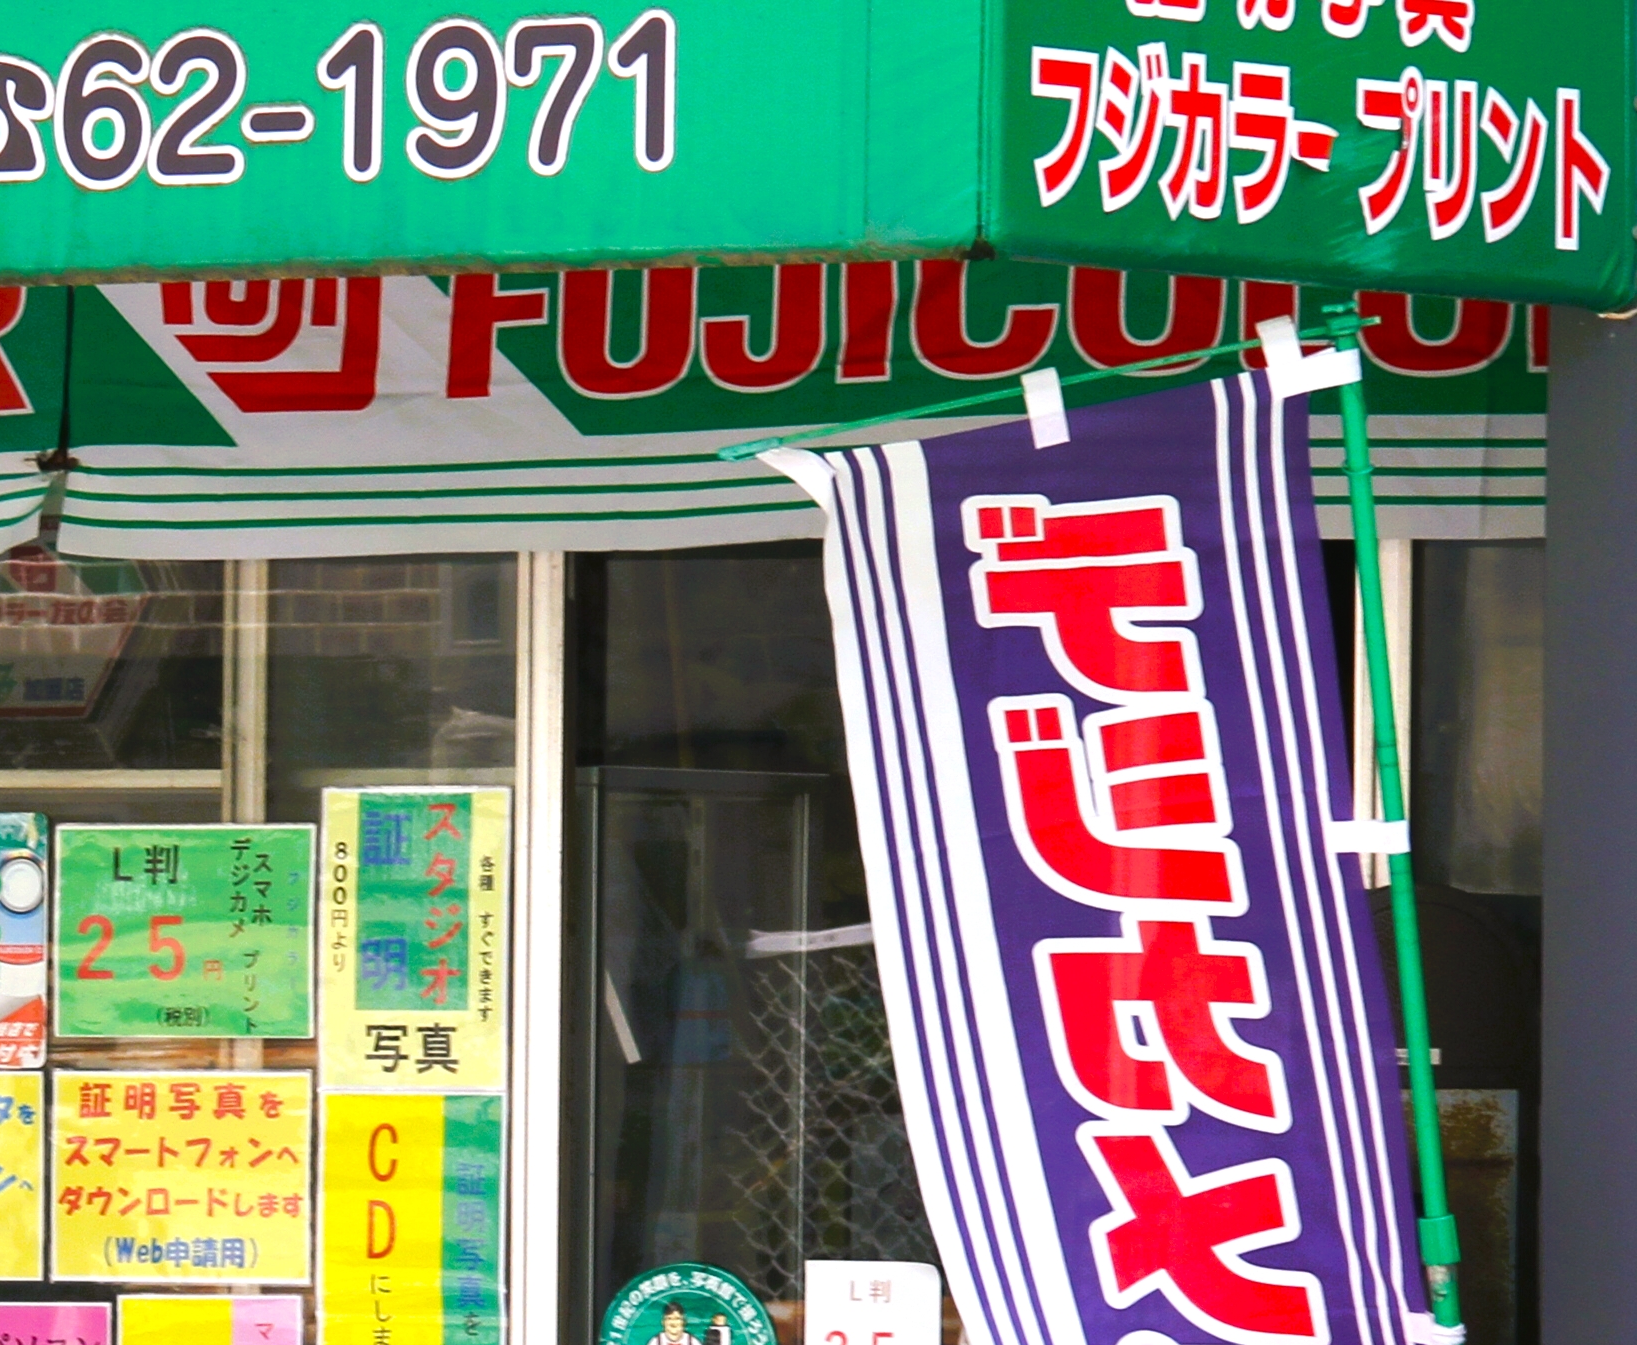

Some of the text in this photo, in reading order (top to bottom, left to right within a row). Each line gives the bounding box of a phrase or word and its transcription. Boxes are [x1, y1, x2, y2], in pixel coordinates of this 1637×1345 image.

[111, 844, 180, 886] L判
[228, 837, 252, 939] デジカメ
[251, 852, 273, 927] スマホ
[361, 810, 413, 992] 証明
[419, 802, 464, 1005] スタジオ
[242, 950, 260, 1035] プリント
[364, 1022, 460, 1075] 写真
[78, 1082, 285, 1121] 証明写真を
[63, 1135, 299, 1168] スマートフォンへ
[57, 1187, 304, 1219] ダウンロードします
